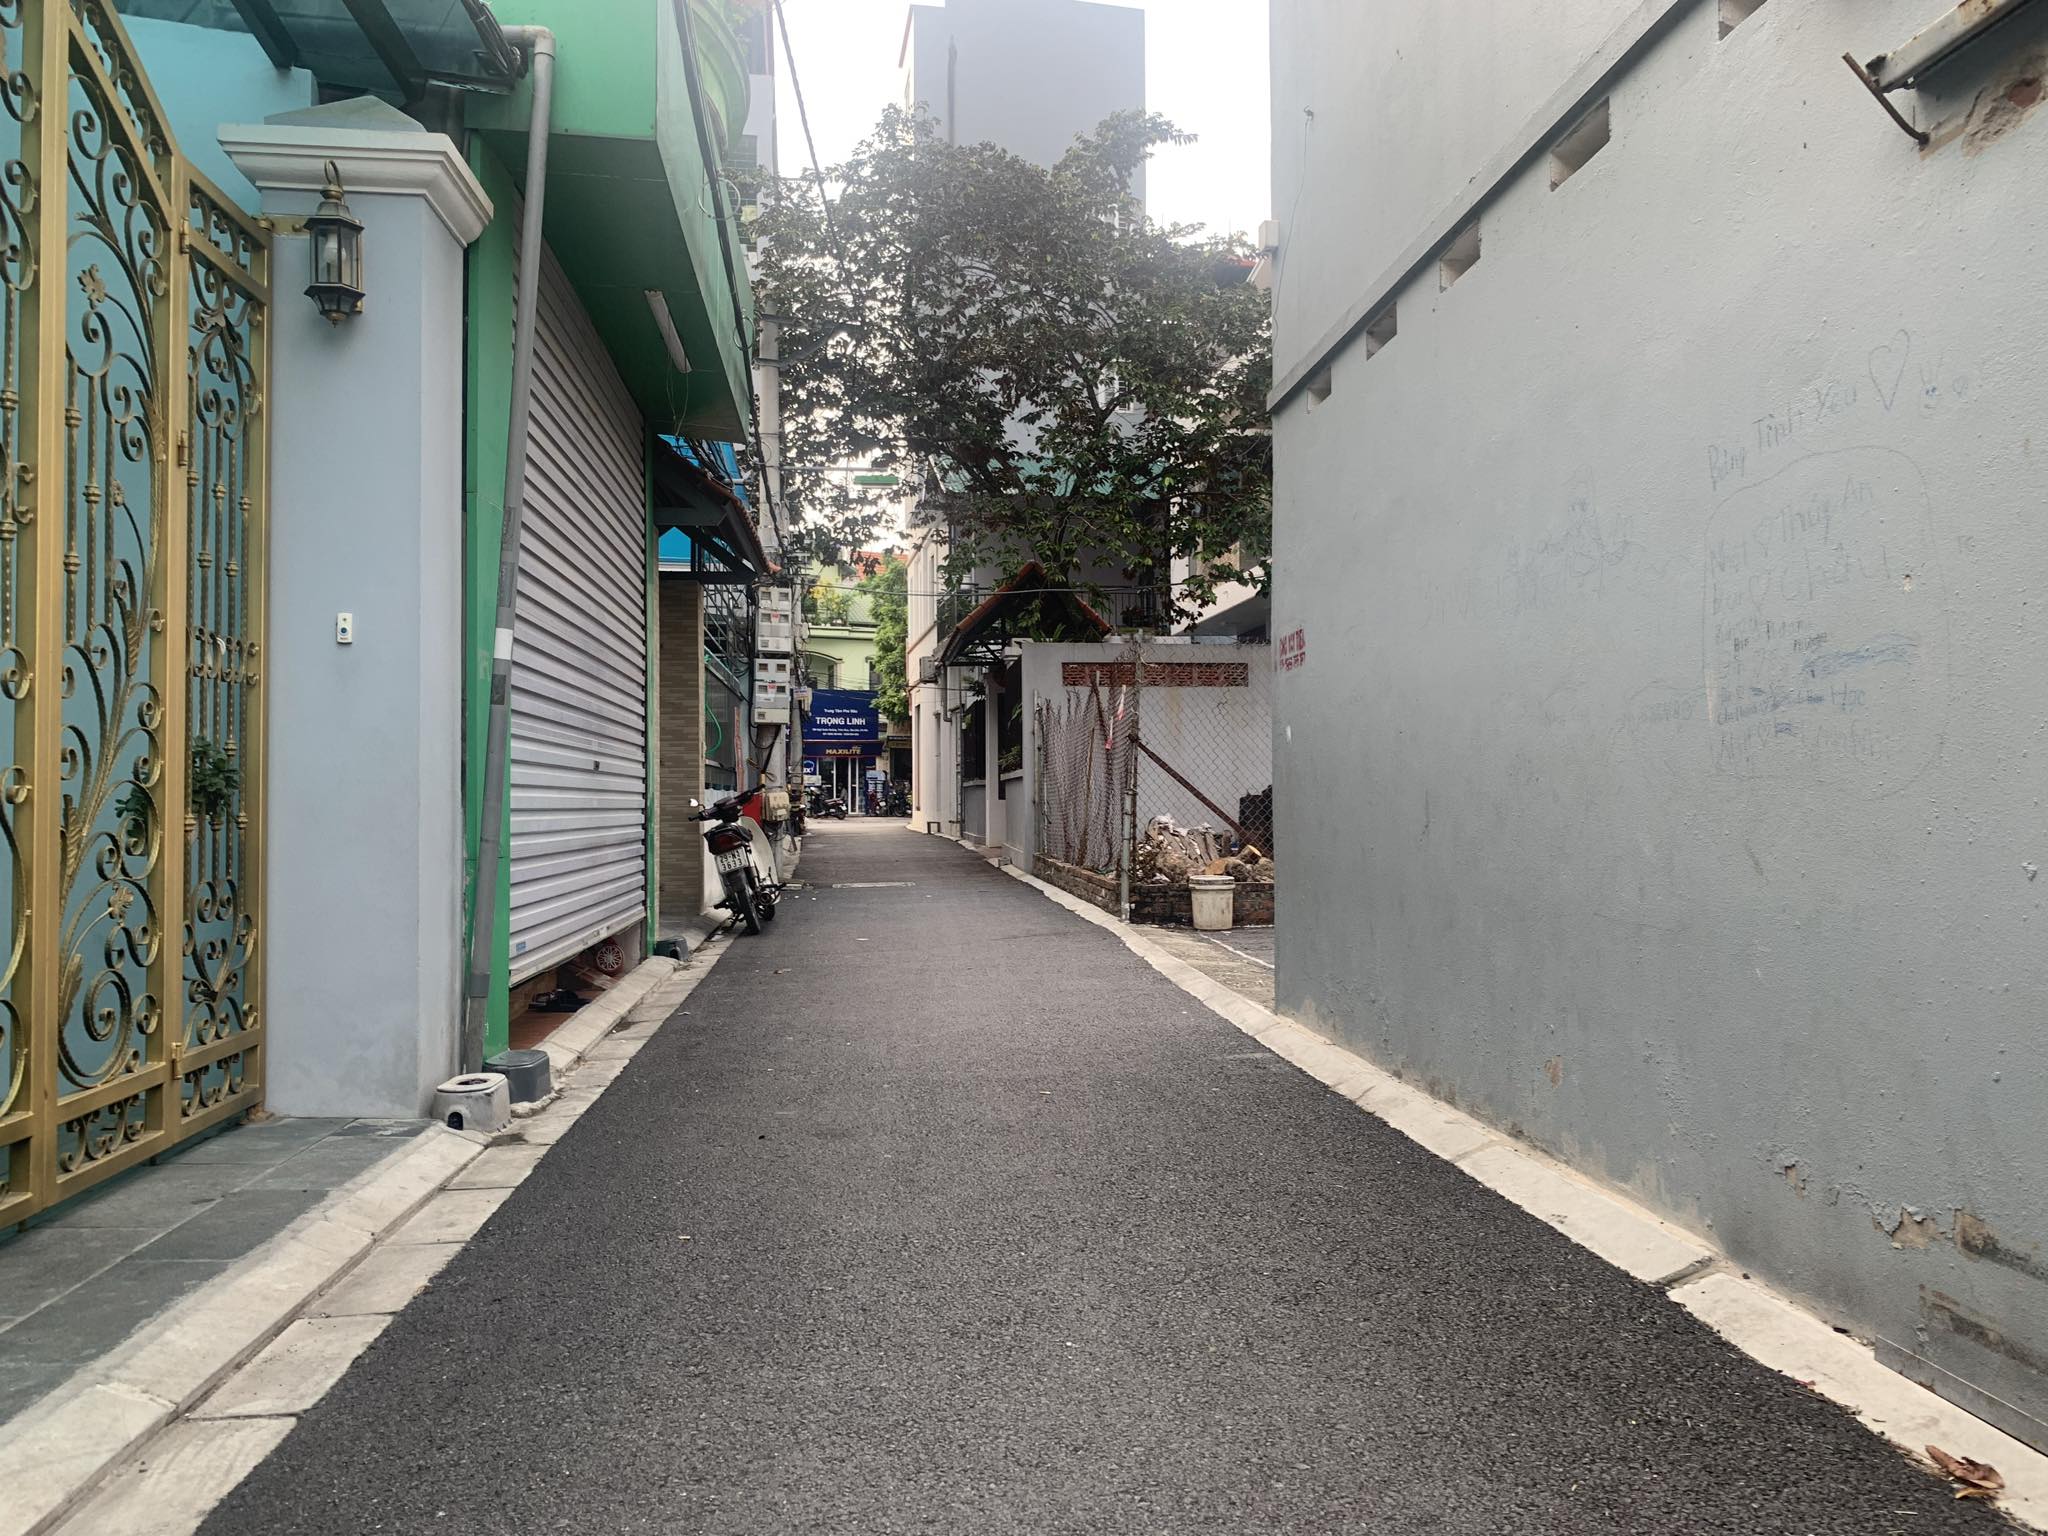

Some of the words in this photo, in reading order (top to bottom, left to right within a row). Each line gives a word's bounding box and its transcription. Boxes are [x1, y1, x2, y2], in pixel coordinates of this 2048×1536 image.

[815, 717, 845, 726] TRỌNG
[846, 717, 866, 726] LINH
[825, 747, 861, 755] MAXILITE
